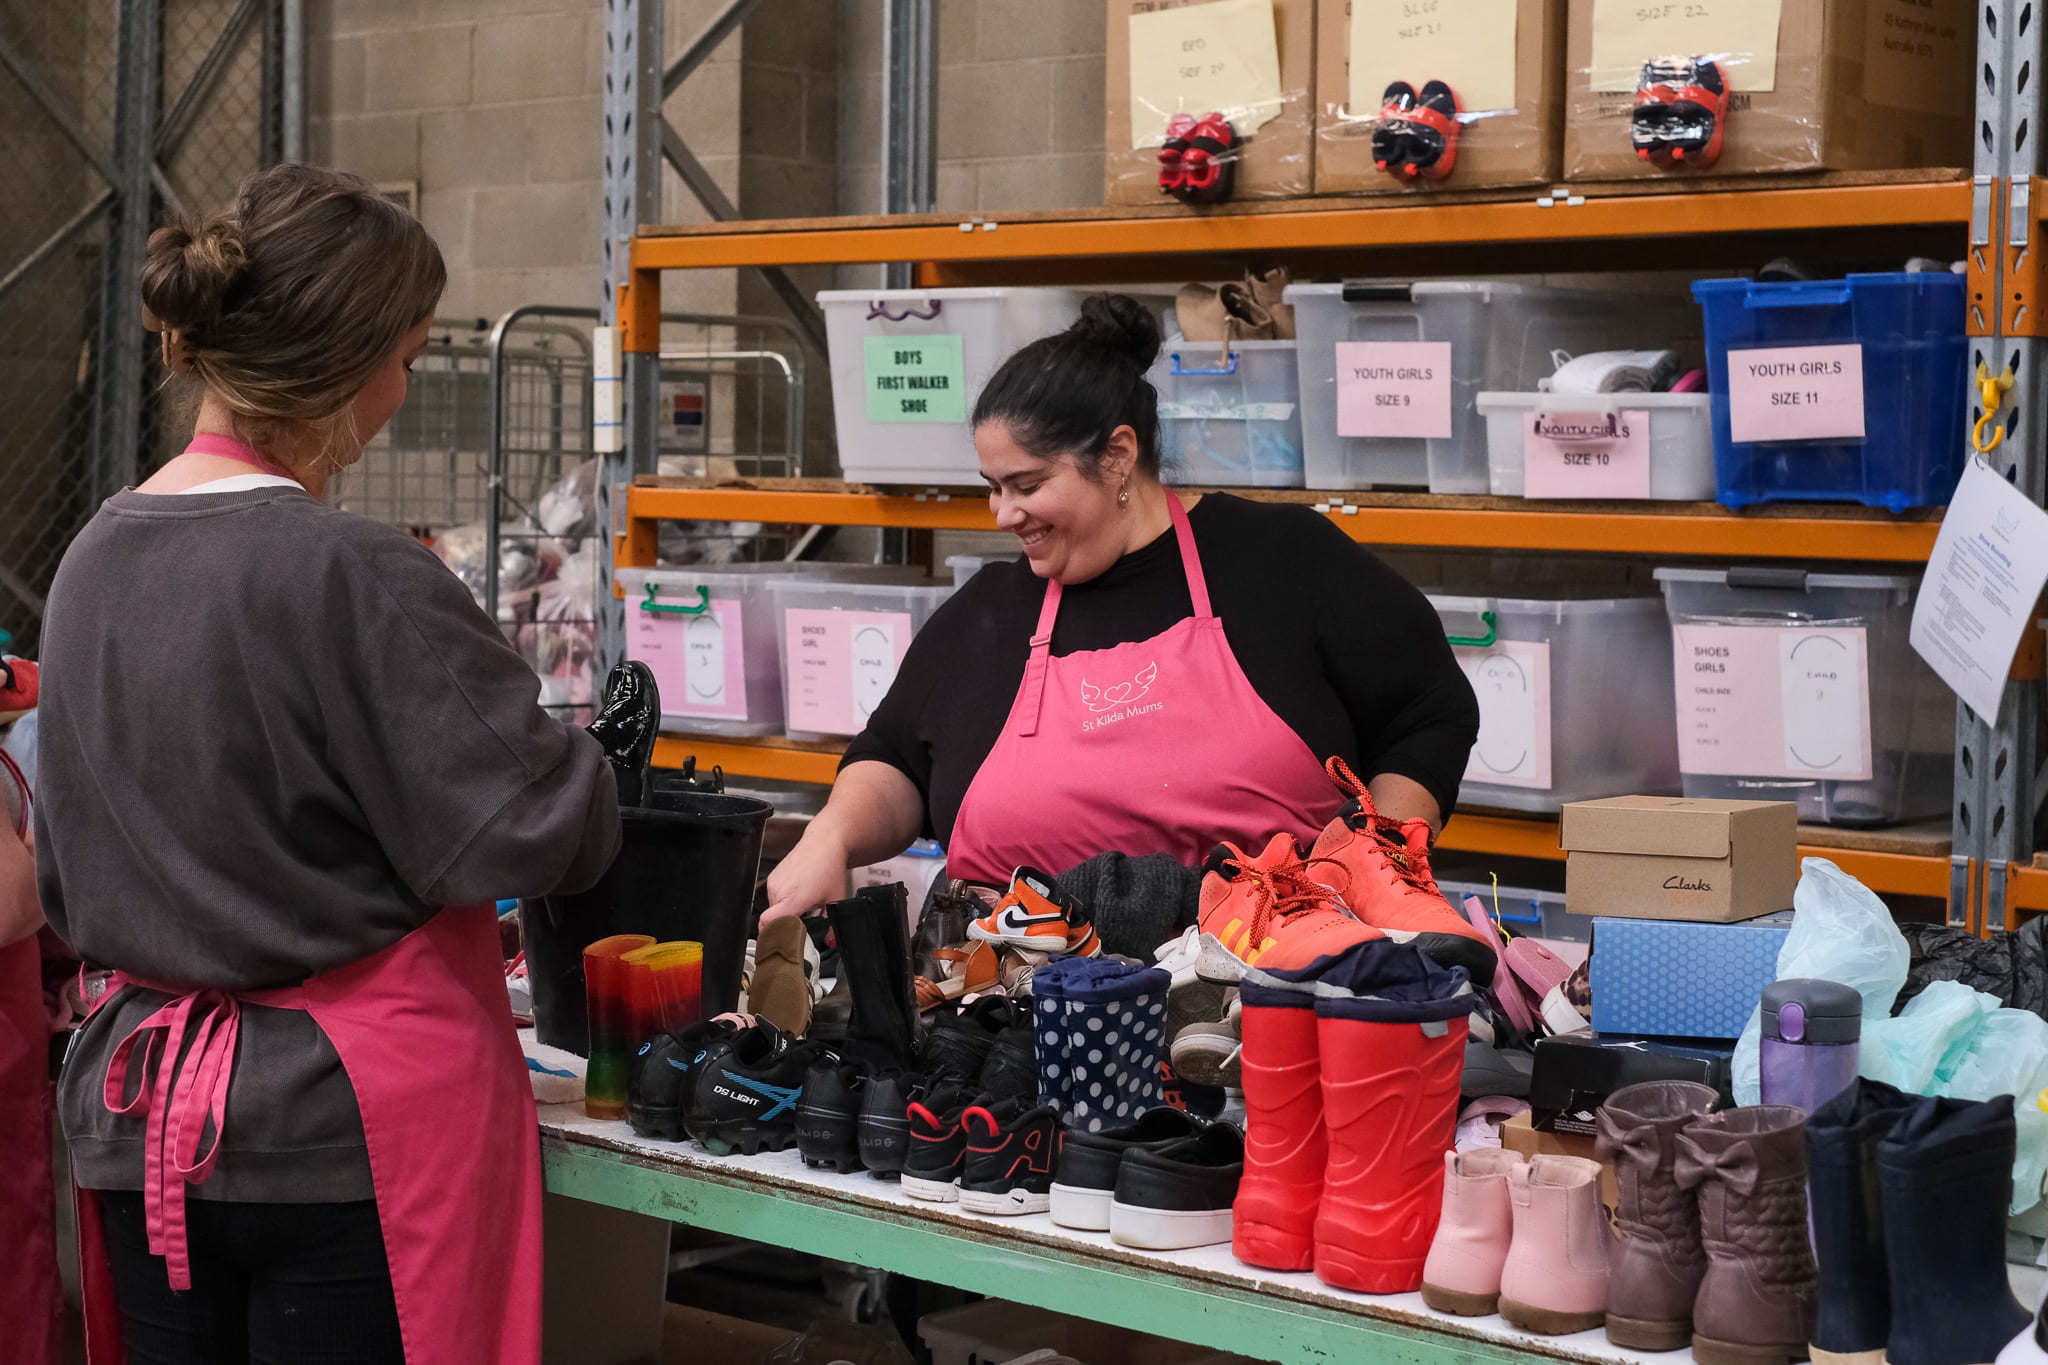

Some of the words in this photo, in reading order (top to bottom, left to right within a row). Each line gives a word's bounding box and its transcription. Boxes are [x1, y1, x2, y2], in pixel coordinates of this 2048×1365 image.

[894, 350, 922, 365] BOYS
[1353, 367, 1394, 380] YOUTH
[1397, 367, 1433, 380] GIRLS
[1748, 362, 1796, 377] YOUTH
[1799, 360, 1842, 375] GIRLS
[877, 376, 904, 390] FIRST
[907, 376, 949, 390] WALKER
[1375, 394, 1400, 406] SIZE
[1403, 394, 1411, 407] 9
[1771, 391, 1800, 406] SIZE
[1805, 391, 1819, 404] 11
[901, 399, 928, 413] SHOE
[1563, 453, 1592, 466] SIZE
[1596, 453, 1610, 466] 10
[801, 625, 826, 635] SHOES
[1694, 646, 1730, 658] SHOES
[1694, 662, 1726, 674] GIRLS
[1082, 720, 1095, 732] St
[1097, 712, 1124, 727] Kilda
[1127, 702, 1163, 717] Mums
[1662, 875, 1711, 891] Clarks
[713, 1084, 729, 1097] DS
[729, 1091, 760, 1107] LIGHT
